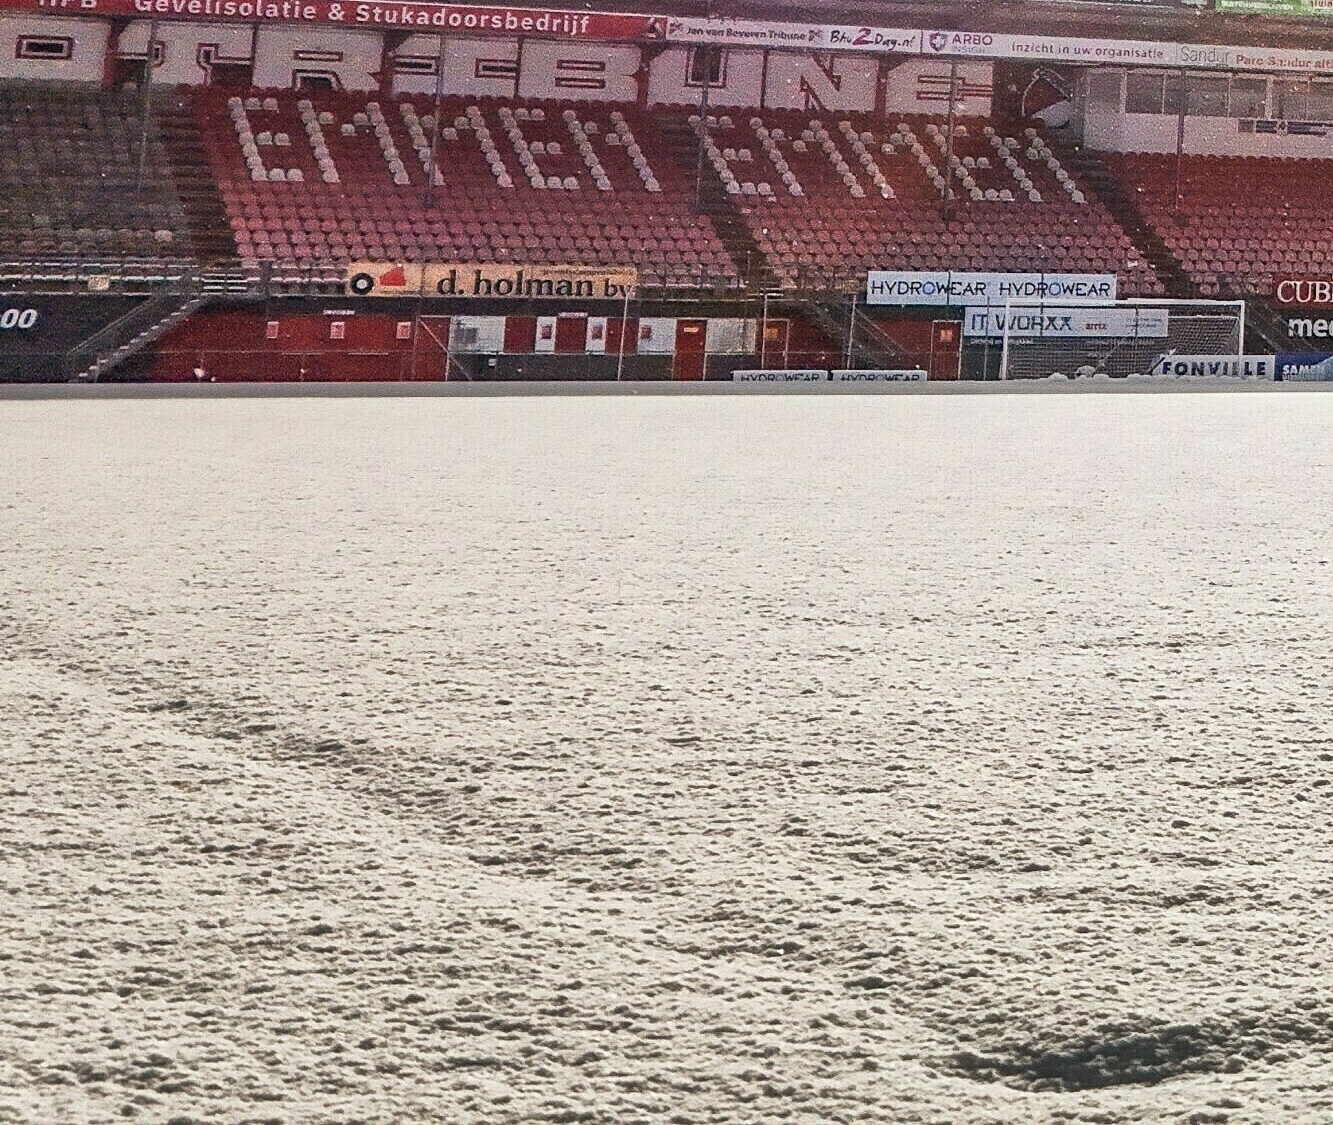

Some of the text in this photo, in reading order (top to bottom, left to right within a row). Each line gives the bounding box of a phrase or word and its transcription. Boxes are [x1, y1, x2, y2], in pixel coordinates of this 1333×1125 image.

[328, 2, 345, 21] &
[355, 4, 590, 34] Stukadoorsbedrijf
[706, 29, 724, 37] van
[952, 34, 992, 45] ARBO
[1058, 44, 1069, 54] in
[1074, 47, 1092, 55] uw
[1095, 47, 1163, 61] organisatie
[1180, 46, 1230, 63] Sandur
[228, 95, 661, 190] EMMEN
[437, 270, 464, 295] d.
[473, 269, 593, 296] holman
[871, 280, 1110, 299] HYDROWEAR HYDROWEAR
[971, 314, 988, 330] IT
[1162, 361, 1266, 376] FONVILLE
